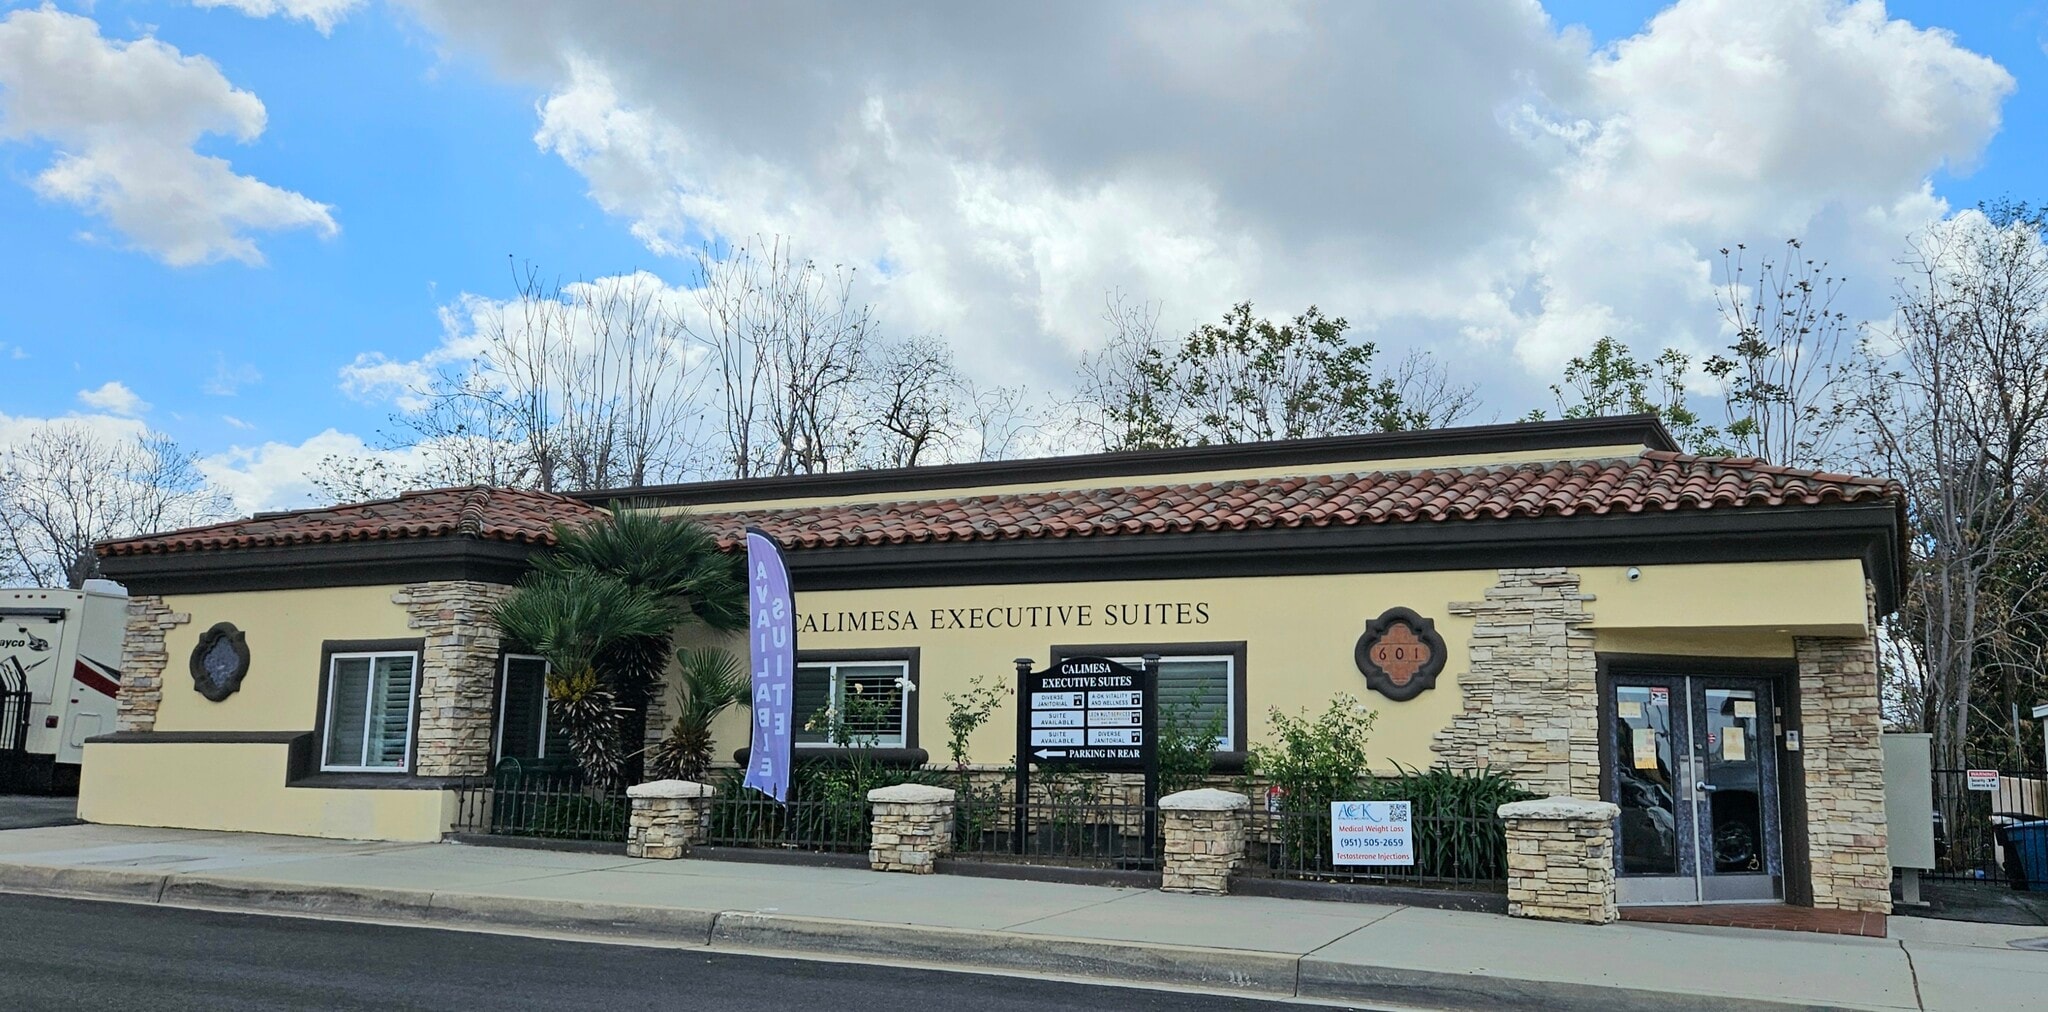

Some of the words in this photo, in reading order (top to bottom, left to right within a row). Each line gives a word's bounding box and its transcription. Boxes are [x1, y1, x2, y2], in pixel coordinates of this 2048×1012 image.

[930, 605, 1093, 630] EXECUTIVE
[1104, 602, 1210, 626] SUITES
[1379, 647, 1418, 660] 601
[1061, 663, 1111, 674] CALIMESA
[1042, 677, 1097, 688] EXECUTIVE
[1098, 676, 1132, 687] SUITES
[1069, 749, 1106, 759] PARKING
[1107, 749, 1116, 758] IN
[1117, 749, 1140, 758] REAR
[1365, 826, 1389, 834] Weight
[1340, 838, 1362, 848] (951)
[1364, 838, 1404, 847] 505-2659
[1377, 853, 1410, 861] Injections
